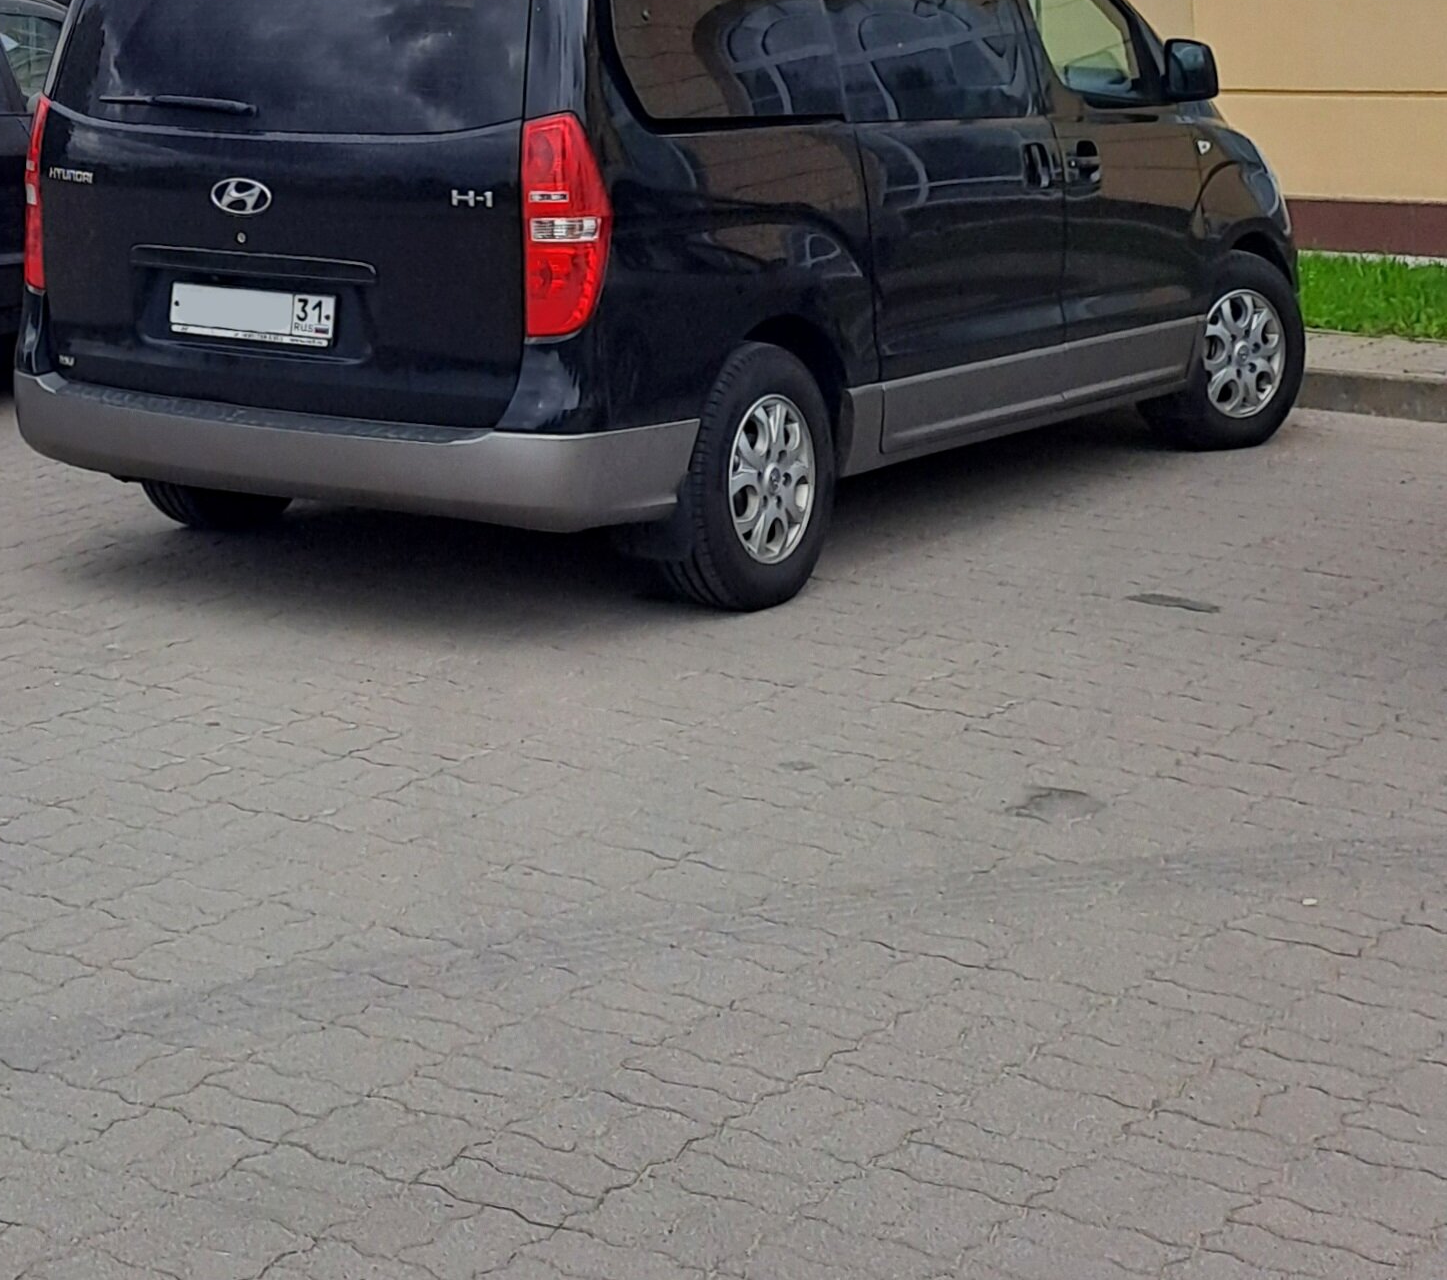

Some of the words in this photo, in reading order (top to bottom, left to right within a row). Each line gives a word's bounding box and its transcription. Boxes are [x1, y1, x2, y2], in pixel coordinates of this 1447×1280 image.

[48, 166, 94, 185] HYUNDAI
[451, 189, 494, 208] H-1
[295, 298, 323, 324] 31
[293, 321, 314, 333] RUS
